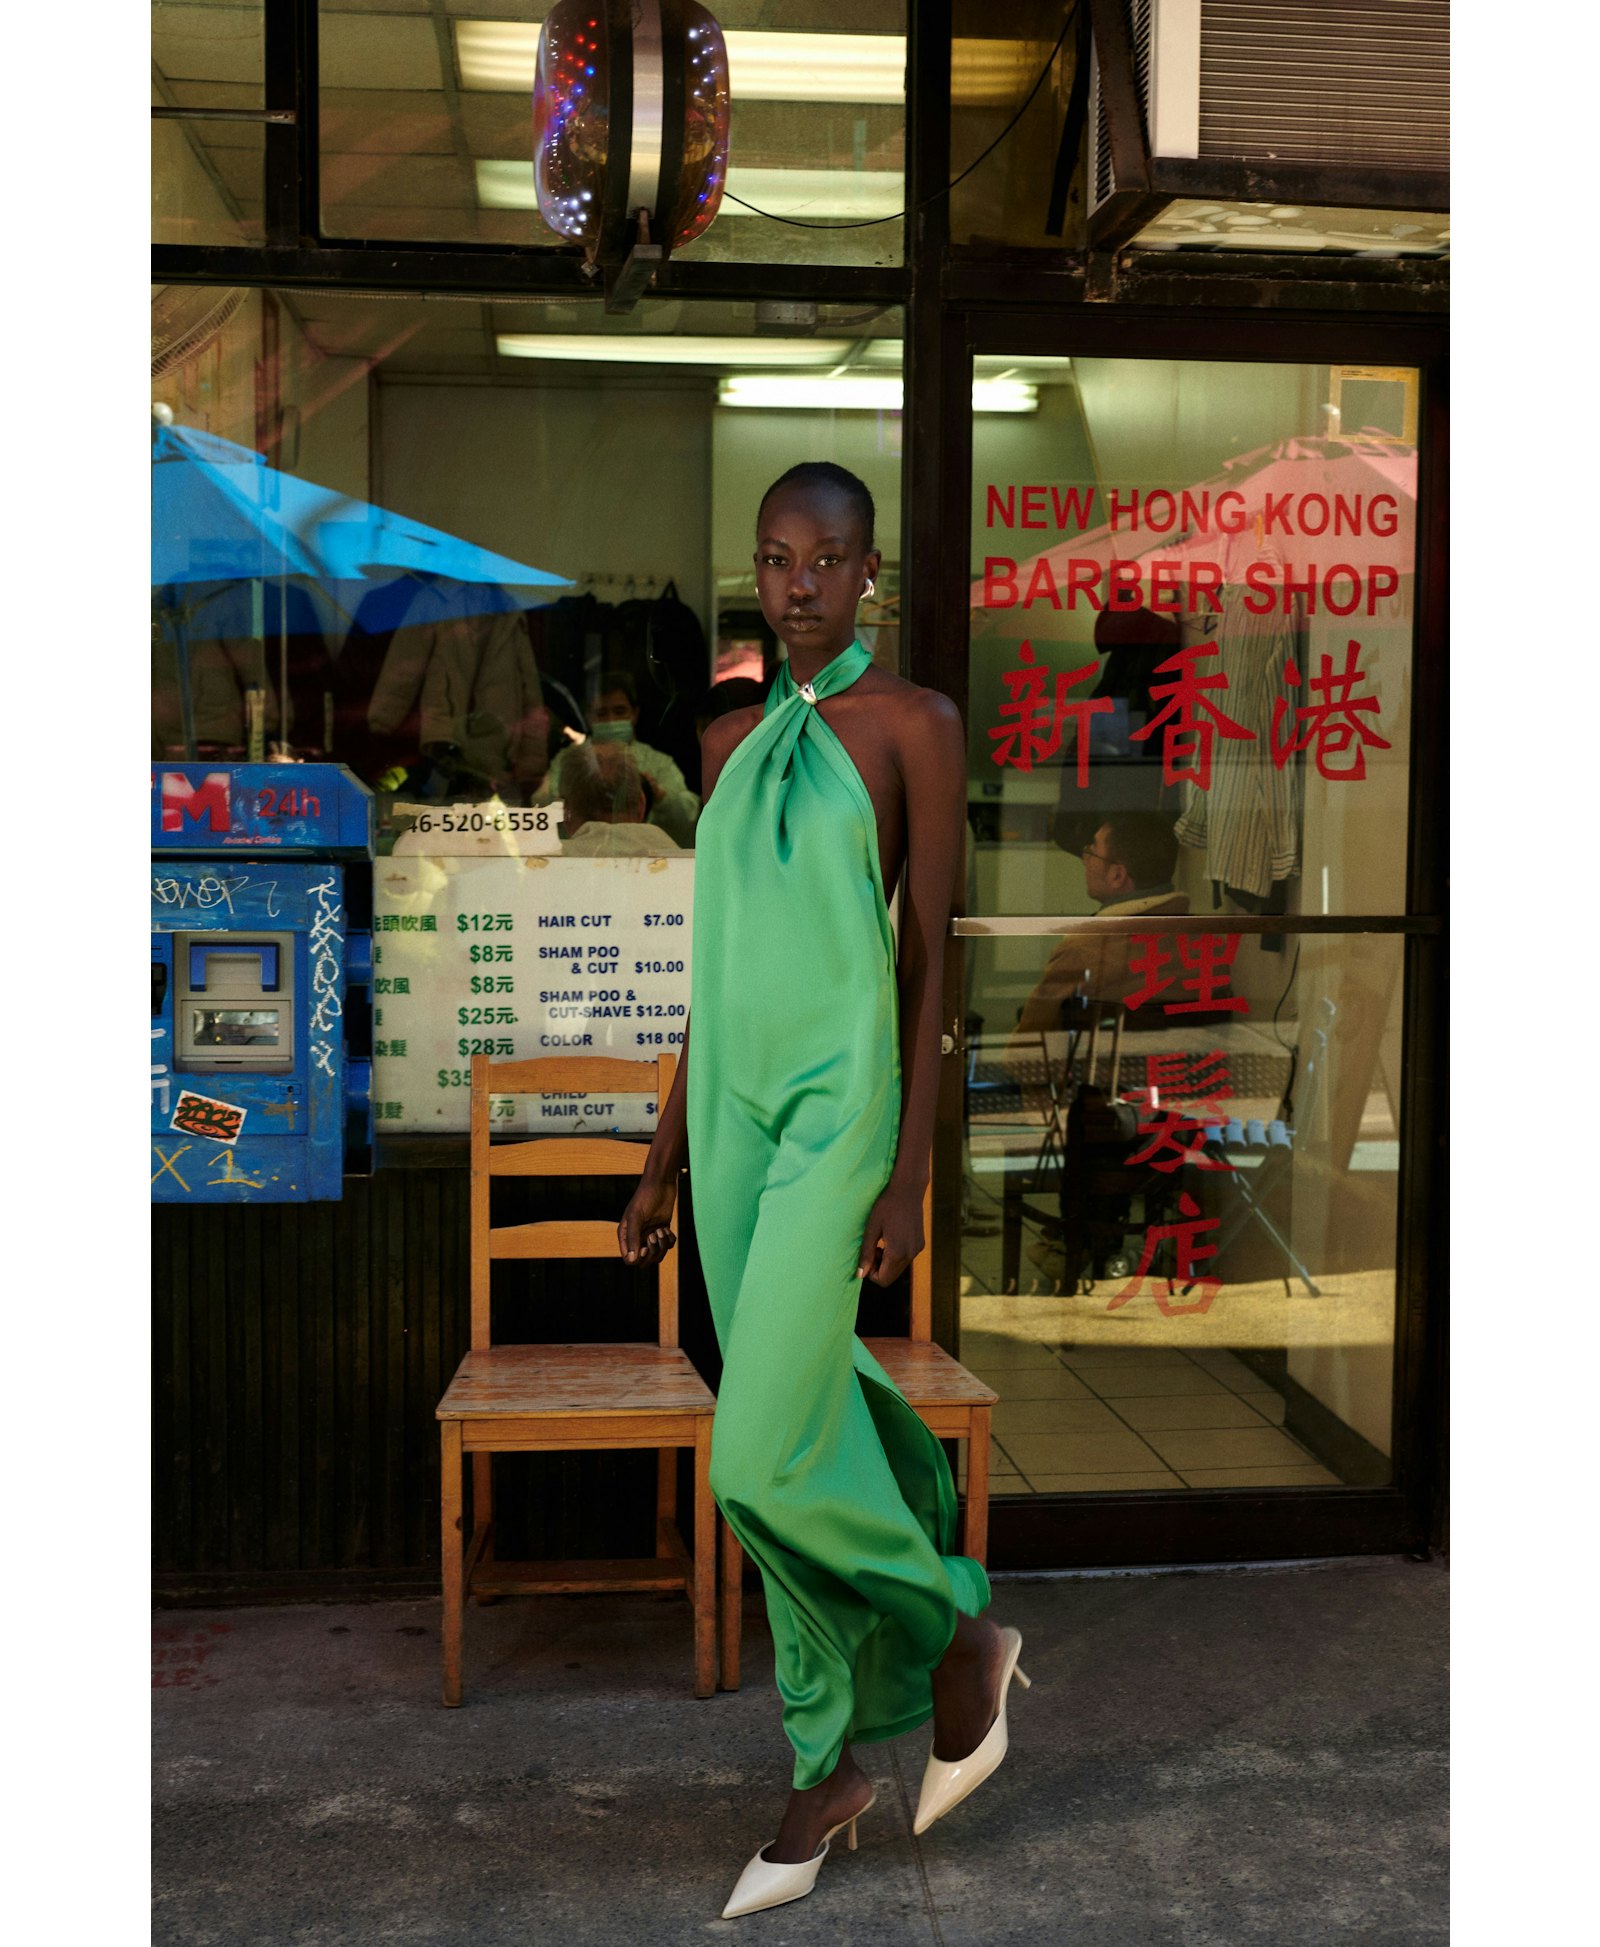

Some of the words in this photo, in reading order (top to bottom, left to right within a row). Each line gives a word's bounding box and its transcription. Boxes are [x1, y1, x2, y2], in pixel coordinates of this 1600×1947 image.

[986, 485, 1095, 530] NEW
[1111, 488, 1246, 534] HONG
[1264, 493, 1398, 537] KONG
[984, 556, 1223, 614] BARBER
[1243, 563, 1398, 616] SHOP
[988, 639, 1392, 791] 新香港
[151, 772, 231, 832] M
[258, 788, 321, 817] 24h
[457, 913, 513, 933] $12元
[538, 915, 576, 928] HAIR
[580, 915, 612, 927] CUT
[643, 914, 684, 927] $7.00
[469, 944, 513, 964] $8元
[538, 946, 583, 959] SHAM
[588, 946, 620, 958] POO
[571, 962, 582, 974] &
[587, 962, 618, 974] CUT
[635, 960, 684, 974] $10.00
[470, 975, 514, 995] $8元
[539, 990, 583, 1003] SHAM
[588, 990, 620, 1002] POO
[626, 989, 637, 1001] &
[549, 1005, 631, 1018] CUT-SHAVE
[636, 1004, 685, 1017] $12.00
[458, 1038, 514, 1057] $28元
[540, 1034, 593, 1046] COLOR
[541, 1104, 578, 1117] HAIR
[584, 1103, 614, 1116] CUT
[1107, 934, 1249, 1317] 理髮店
